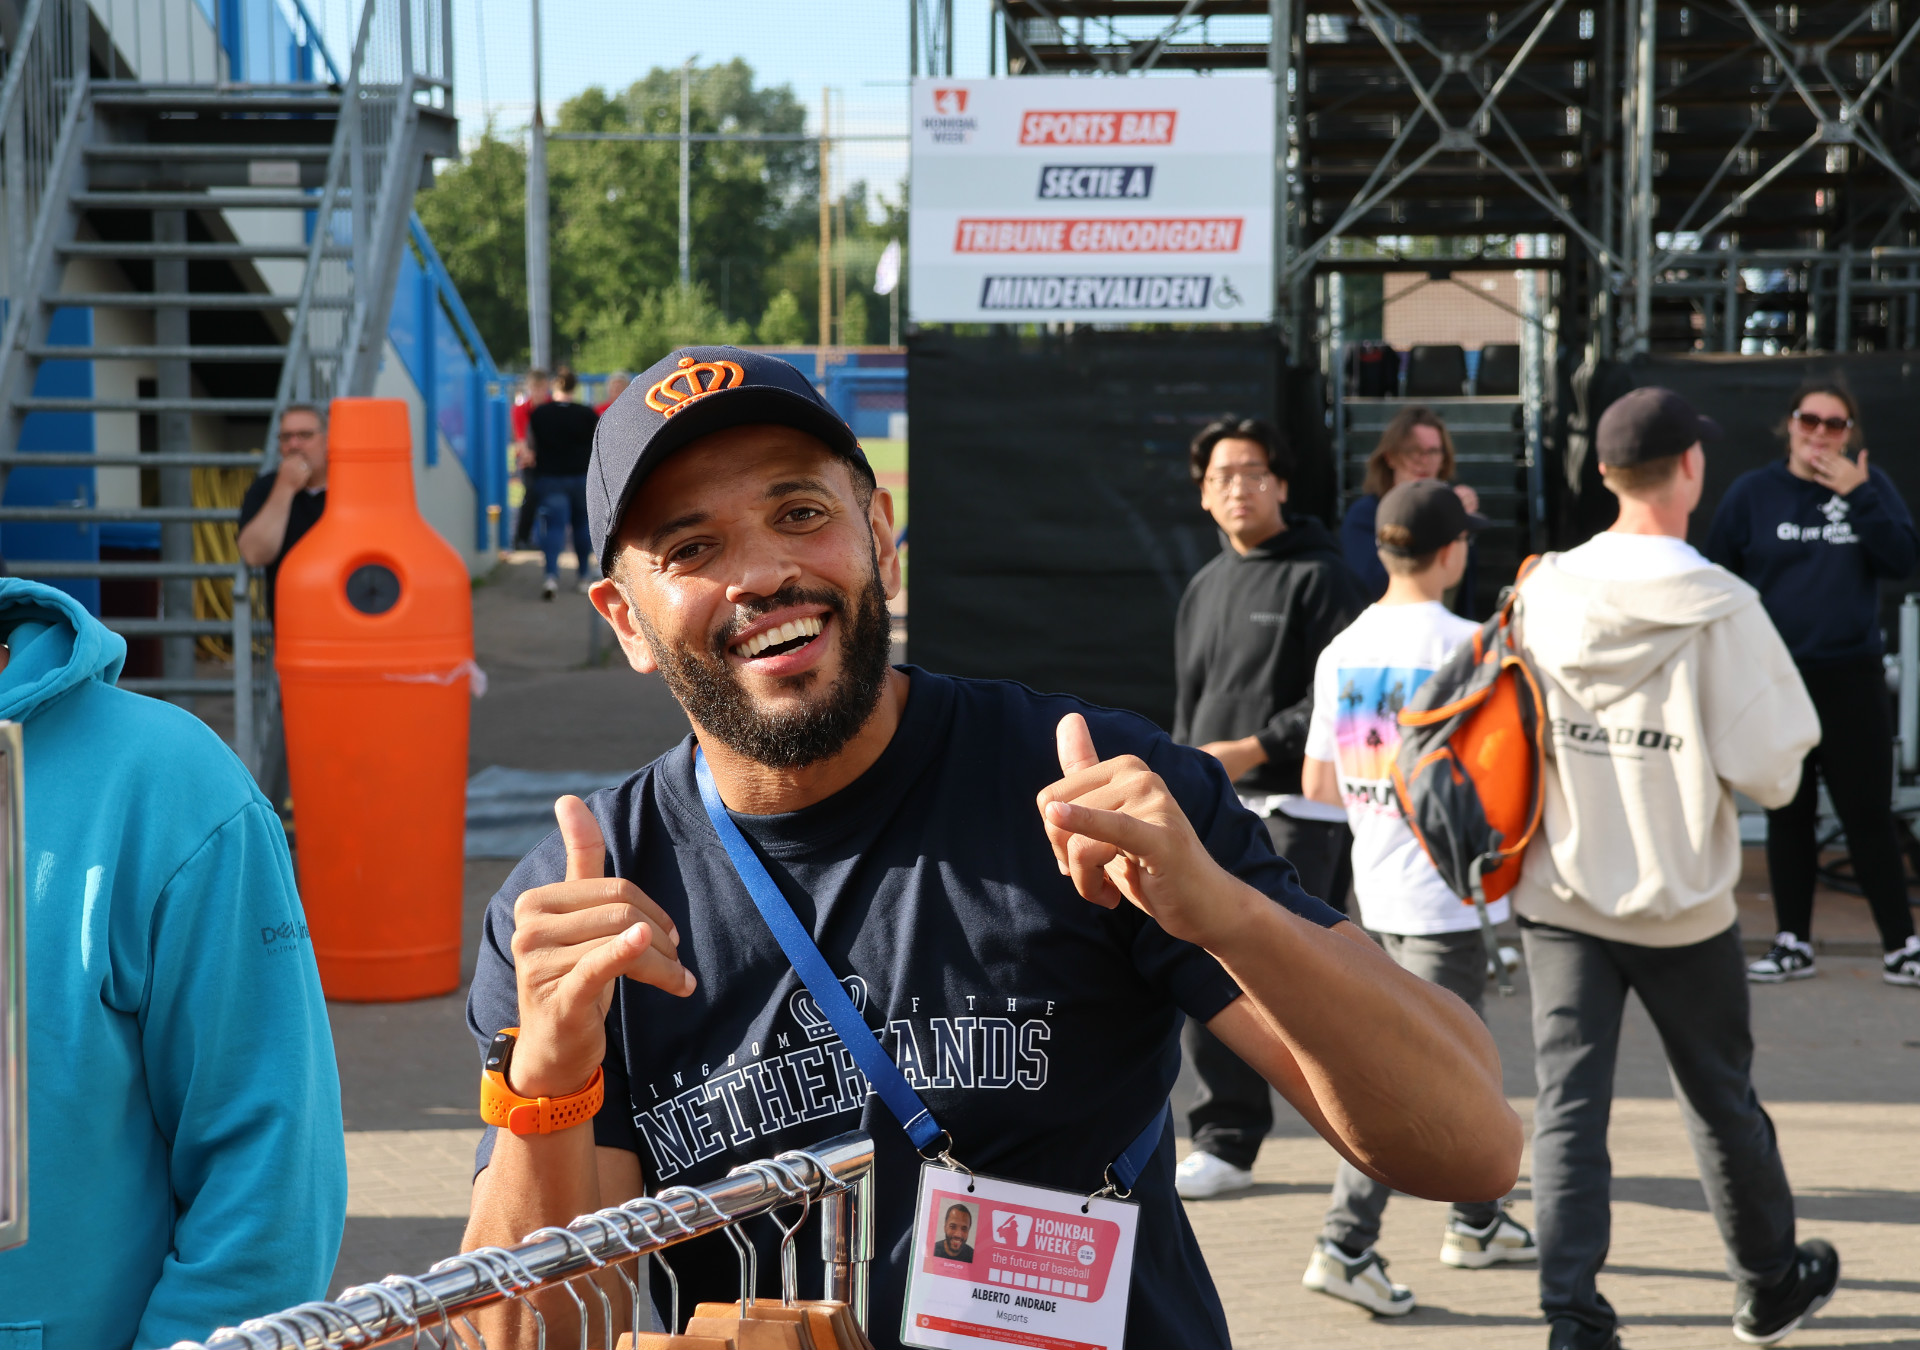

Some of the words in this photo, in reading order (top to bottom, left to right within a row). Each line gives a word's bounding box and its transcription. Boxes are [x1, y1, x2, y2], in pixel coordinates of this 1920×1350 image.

[1024, 113, 1115, 142] SPORTS
[1119, 113, 1169, 142] BAR
[1043, 169, 1123, 197] SECTIE
[1126, 169, 1146, 197] A
[960, 222, 1066, 250] TRIBUNE
[1069, 222, 1237, 250] GENODIGDEN
[986, 278, 1207, 308] MINDERVALIDEN
[966, 995, 1055, 1016] THE
[633, 1016, 1051, 1182] NETHERANDS
[1035, 1217, 1095, 1243] HONKBAL
[1034, 1234, 1071, 1256] WEEK
[992, 1252, 1007, 1265] the
[1010, 1254, 1037, 1270] future
[1040, 1261, 1051, 1272] of
[1051, 1262, 1090, 1279] baseball
[972, 1288, 1010, 1304] ALBERTO
[1015, 1295, 1057, 1313] ANDRADE
[996, 1309, 1028, 1324] Msports
